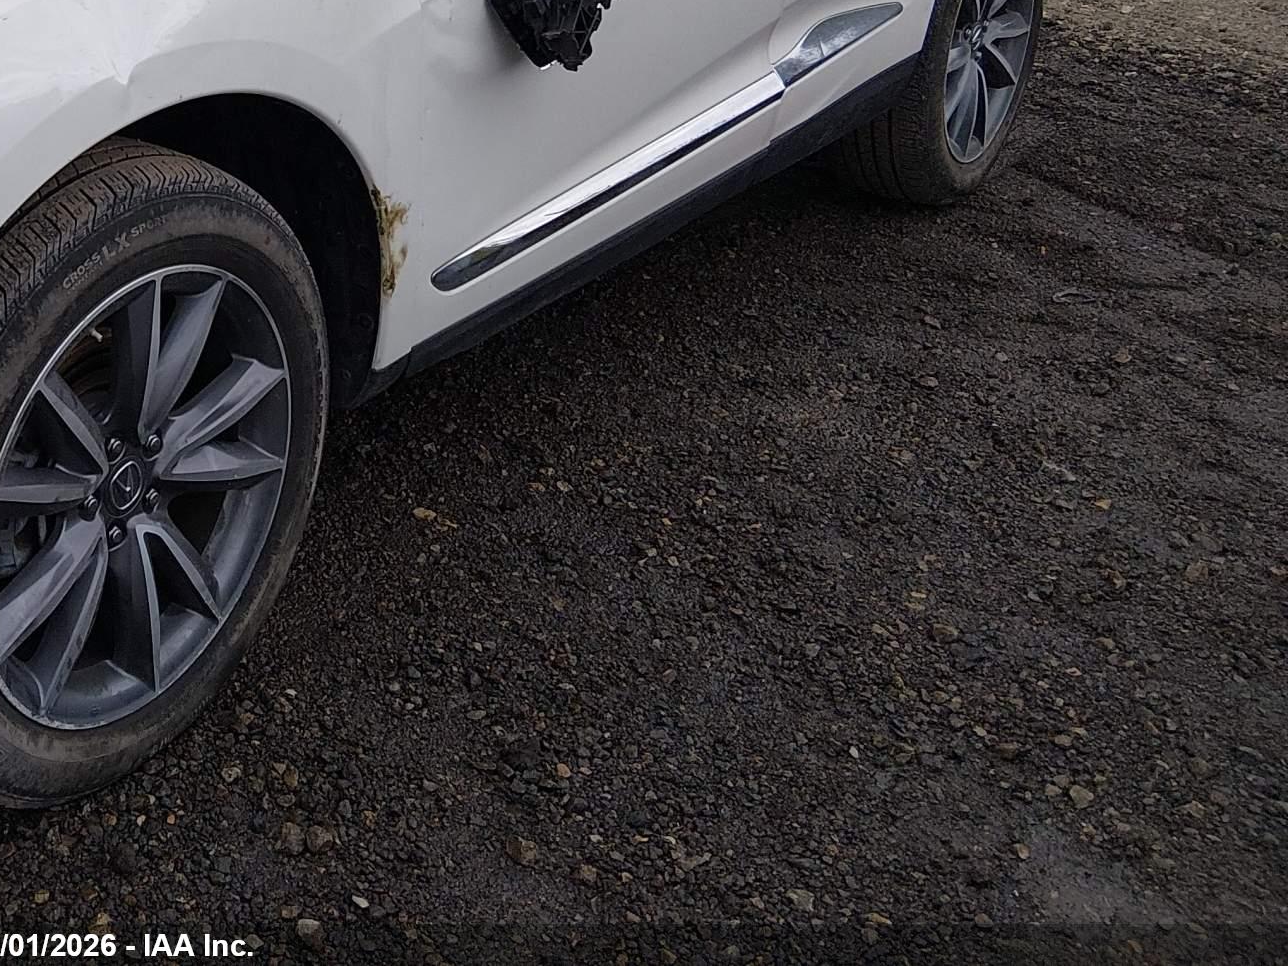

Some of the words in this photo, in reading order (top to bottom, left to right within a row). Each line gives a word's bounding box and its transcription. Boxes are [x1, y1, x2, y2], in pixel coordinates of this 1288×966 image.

[62, 251, 101, 290] CROSS
[101, 232, 131, 261] LX
[129, 214, 167, 238] SPORT
